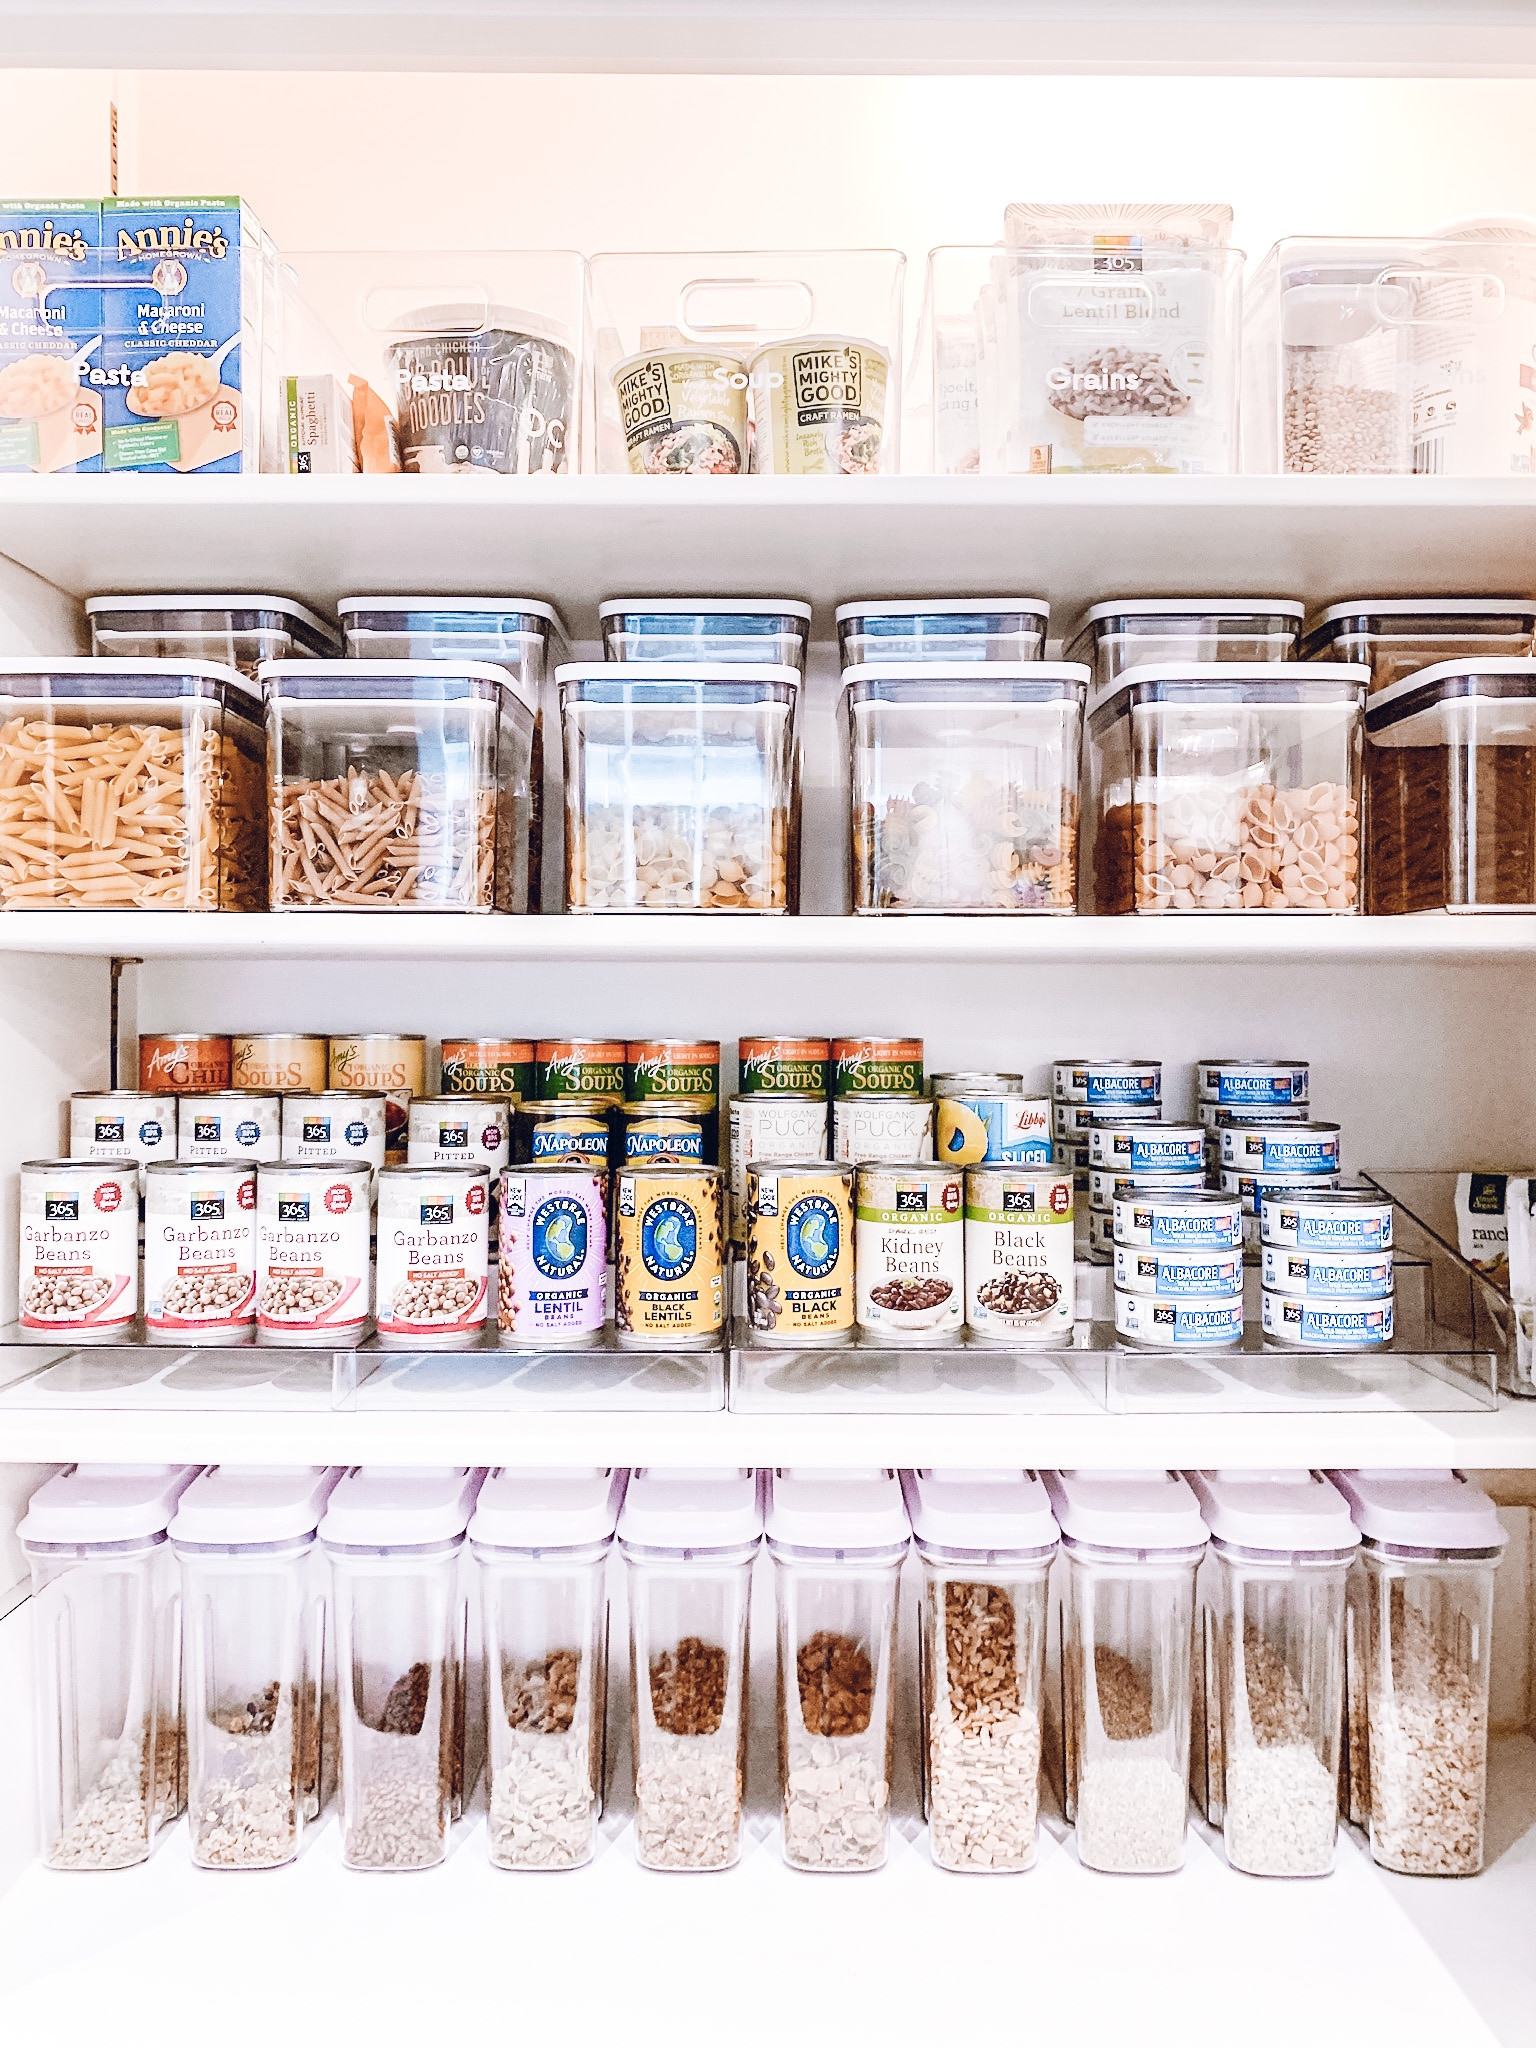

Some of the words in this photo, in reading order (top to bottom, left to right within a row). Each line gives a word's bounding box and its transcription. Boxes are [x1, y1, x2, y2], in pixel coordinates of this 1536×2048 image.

[117, 217, 229, 262] Annie's
[1101, 256, 1136, 271] 365
[137, 303, 206, 319] Macaroni
[1062, 304, 1119, 319] Lentil
[1125, 303, 1181, 320] Blend
[11, 322, 64, 337] Cheese
[138, 321, 148, 335] &
[151, 320, 204, 334] Cheese
[124, 340, 167, 348] CLASSIC
[168, 339, 218, 348] CHEDDAR
[797, 348, 858, 371] MIKE'S
[73, 362, 149, 388] Pasta
[395, 369, 472, 393] Pasta
[619, 362, 662, 397] MIKE'S
[713, 367, 785, 392] Soup
[799, 372, 858, 385] MIGHTY
[1045, 367, 1142, 391] Grains
[622, 383, 663, 411] MIGHTY
[801, 385, 858, 403] GOOD
[305, 392, 320, 446] Spaghetti
[410, 391, 486, 434] NOODLES
[625, 398, 665, 428] GOOD
[800, 411, 828, 423] CRAFT
[830, 410, 860, 421] RAMEN
[289, 401, 298, 448] ORGANIC
[643, 421, 672, 439] RAMEN
[298, 455, 309, 471] 365
[147, 1045, 190, 1078] Amy's
[545, 1049, 586, 1081] Amy's
[634, 1050, 671, 1083] Amy's
[744, 1045, 780, 1079] Amy's
[776, 1064, 810, 1073] ORGANIC
[836, 1046, 872, 1080] Amy's
[867, 1065, 901, 1073] ORGANIC
[237, 1062, 302, 1087] SOUPS
[340, 1063, 406, 1088] SOUPS
[462, 1068, 500, 1077] ORGANIC
[566, 1066, 624, 1091] SOUPS
[582, 1067, 613, 1075] ORGANIC
[668, 1068, 701, 1076] ORGANIC
[761, 1064, 822, 1088] SOUPS
[852, 1064, 914, 1089] SOUPS
[450, 1068, 515, 1092] SOUPS
[652, 1067, 713, 1092] SOUPS
[1092, 1078, 1140, 1092] ALBACORE
[1223, 1078, 1271, 1092] ALBACORE
[758, 1109, 818, 1119] WOLFGANG
[853, 1110, 916, 1119] WOLFGANG
[98, 1125, 121, 1139] 365
[197, 1124, 218, 1138] 365
[306, 1125, 327, 1138] 365
[758, 1119, 820, 1137] PUCK
[853, 1119, 919, 1137] PUCK
[443, 1131, 465, 1144] 365
[535, 1134, 609, 1156] NAPOLEON
[627, 1135, 702, 1156] NAPOLEON
[758, 1141, 817, 1150] ORGANIC
[853, 1141, 916, 1150] ORGANIC
[89, 1146, 131, 1156] PITTED
[190, 1145, 228, 1155] PITTED
[298, 1146, 337, 1155] PITTED
[1116, 1142, 1131, 1151] 365
[1136, 1143, 1187, 1158] ALBACORE
[1248, 1142, 1263, 1152] 365
[1269, 1144, 1320, 1158] ALBACORE
[434, 1151, 475, 1160] PITTED
[774, 1151, 792, 1159] Range
[869, 1152, 887, 1160] Range
[900, 1193, 925, 1207] 365
[1006, 1194, 1032, 1208] 365
[49, 1202, 76, 1217] 365
[194, 1201, 222, 1217] 365
[281, 1203, 307, 1218] 365
[424, 1206, 450, 1221] 365
[535, 1200, 587, 1227] WESTBRAE
[643, 1201, 695, 1227] WESTBRAE
[789, 1199, 838, 1226] WESTBRAE
[881, 1212, 943, 1222] ORGANIC
[988, 1212, 1051, 1222] ORGANIC
[1136, 1215, 1151, 1226] 365
[1157, 1217, 1213, 1234] ALBACORE
[1282, 1216, 1298, 1227] 365
[1304, 1219, 1361, 1236] ALBACORE
[25, 1226, 110, 1242] Garbanzo
[163, 1226, 250, 1242] Garbanzo
[393, 1230, 478, 1246] Garbanzo
[995, 1230, 1046, 1247] Black
[35, 1245, 91, 1261] Beans
[179, 1245, 236, 1261] Beans
[269, 1246, 322, 1262] Beans
[881, 1237, 944, 1256] Kidney
[409, 1250, 464, 1265] Beans
[886, 1256, 940, 1273] Beans
[993, 1249, 1047, 1267] Beans
[1140, 1263, 1156, 1275] 365
[1162, 1266, 1218, 1283] ALBACORE
[1290, 1263, 1307, 1275] 365
[1313, 1267, 1370, 1283] ALBACORE
[536, 1290, 583, 1300] ORGANIC
[644, 1292, 693, 1300] ORGANIC
[792, 1289, 837, 1299] ORGANIC
[534, 1302, 584, 1313] LENTIL
[652, 1303, 685, 1311] BLACK
[792, 1300, 837, 1313] BLACK
[1285, 1309, 1301, 1320] 365
[644, 1312, 692, 1321] LENTILS
[1156, 1311, 1174, 1322] 365
[1180, 1311, 1231, 1328] ALBACORE
[1307, 1312, 1364, 1329] ALBACORE
